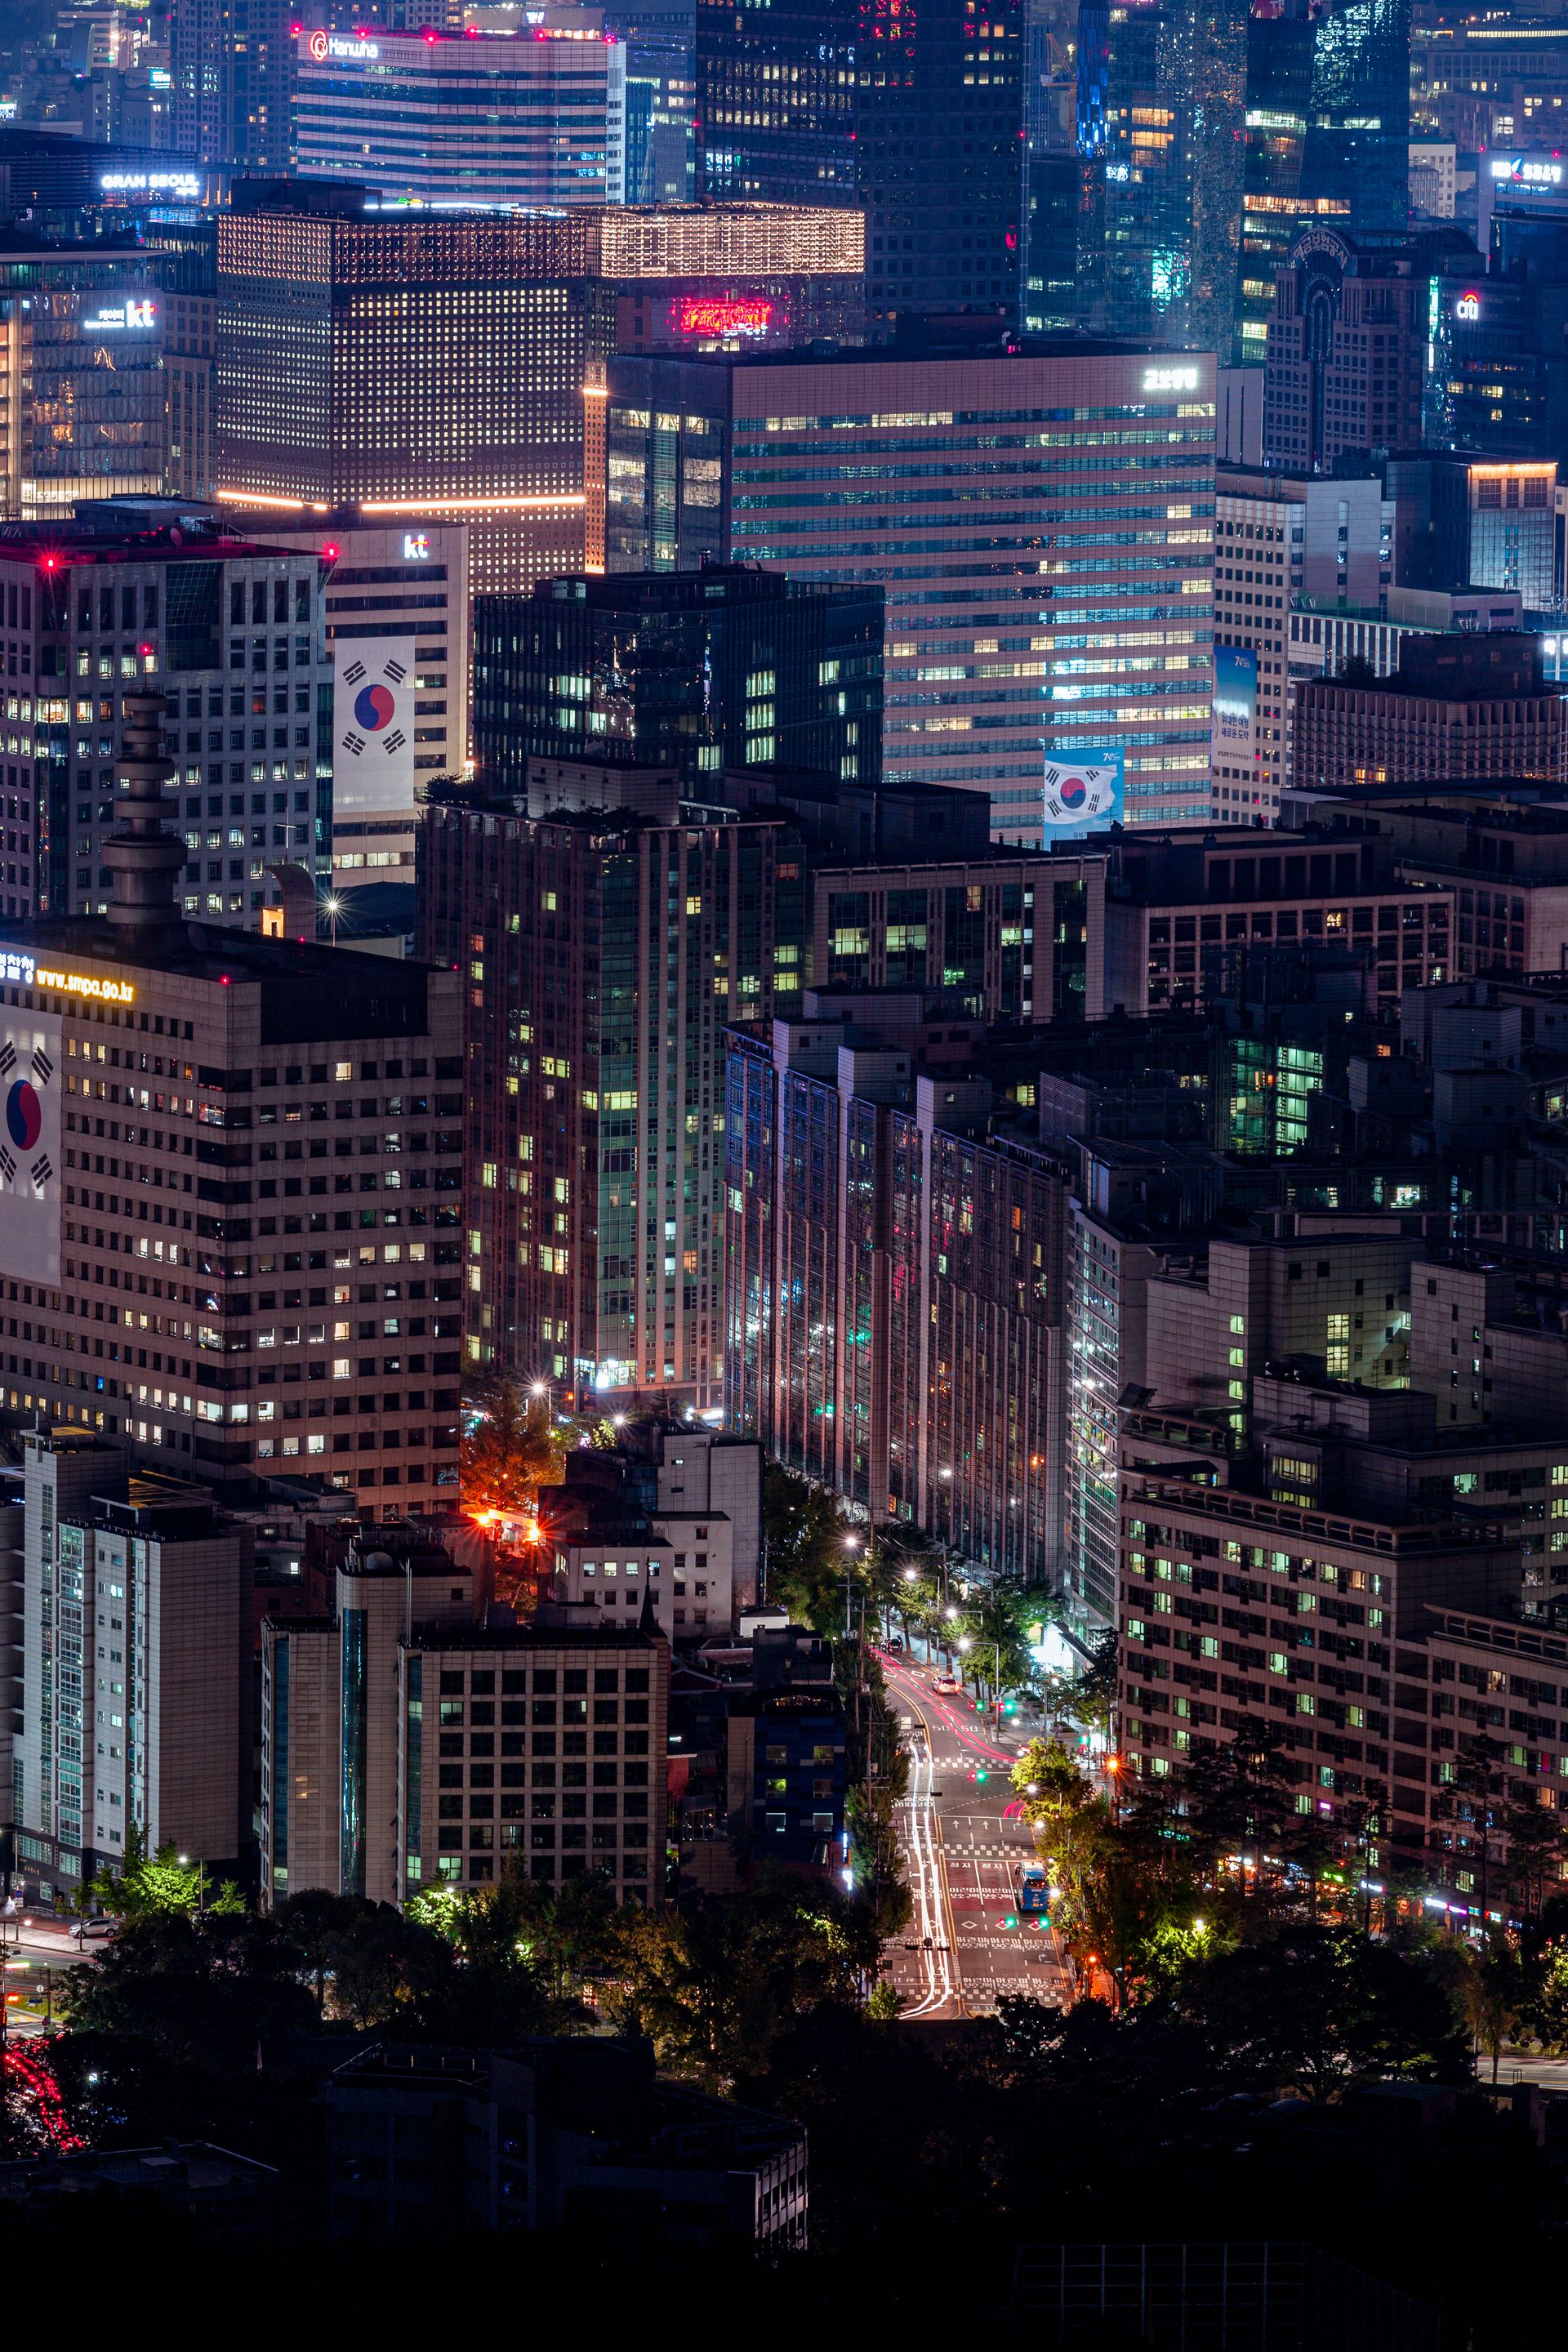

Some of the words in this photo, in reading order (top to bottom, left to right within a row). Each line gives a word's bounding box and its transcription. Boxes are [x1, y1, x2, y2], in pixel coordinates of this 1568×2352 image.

[328, 38, 378, 58] Hanwha
[101, 175, 146, 188] GRAN
[149, 174, 199, 187] SEOUL
[127, 300, 155, 327] kt
[1457, 294, 1478, 319] citi
[404, 534, 430, 559] kt
[1222, 715, 1237, 727] 위대한
[1238, 718, 1249, 728] 여정
[1221, 727, 1237, 739] 새로운
[1238, 730, 1249, 741] 도약
[36, 969, 134, 1001] www.smpa.go.kr
